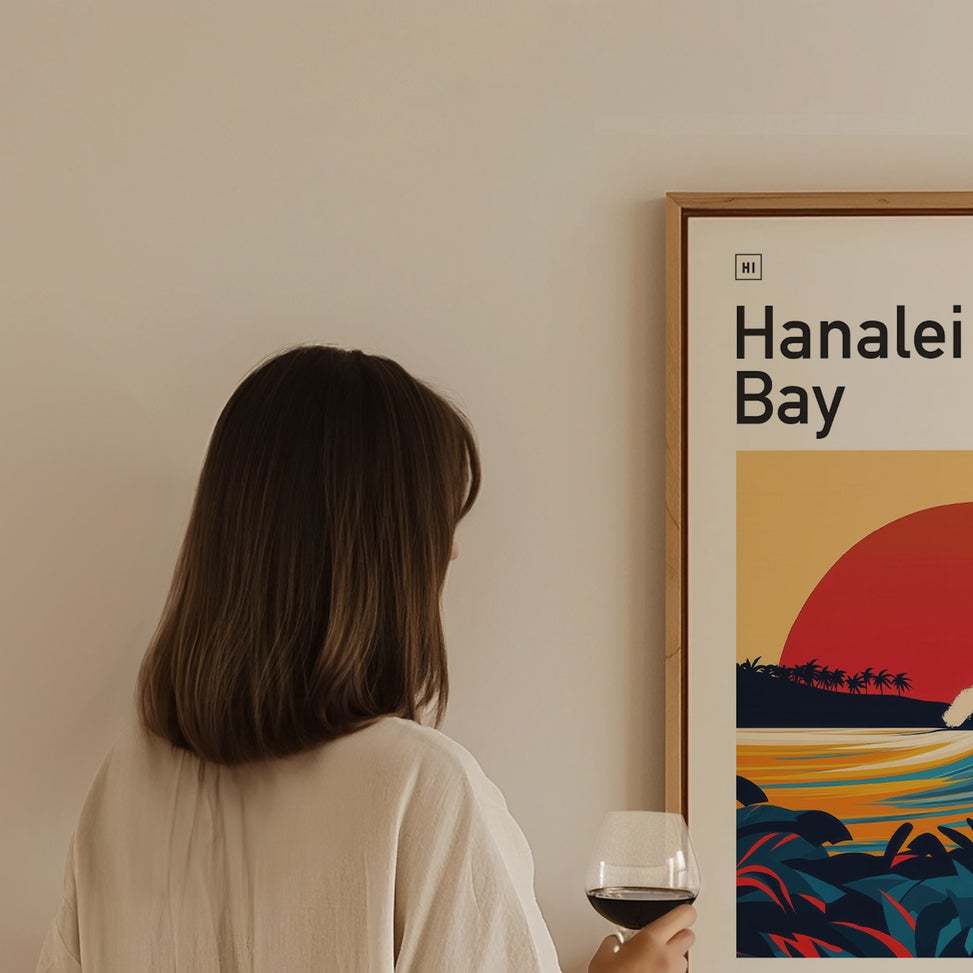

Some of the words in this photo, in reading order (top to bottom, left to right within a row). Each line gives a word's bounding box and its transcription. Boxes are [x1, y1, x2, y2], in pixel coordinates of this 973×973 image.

[742, 262, 755, 273] HI
[736, 305, 962, 359] Hanalei
[736, 370, 846, 440] Bay
